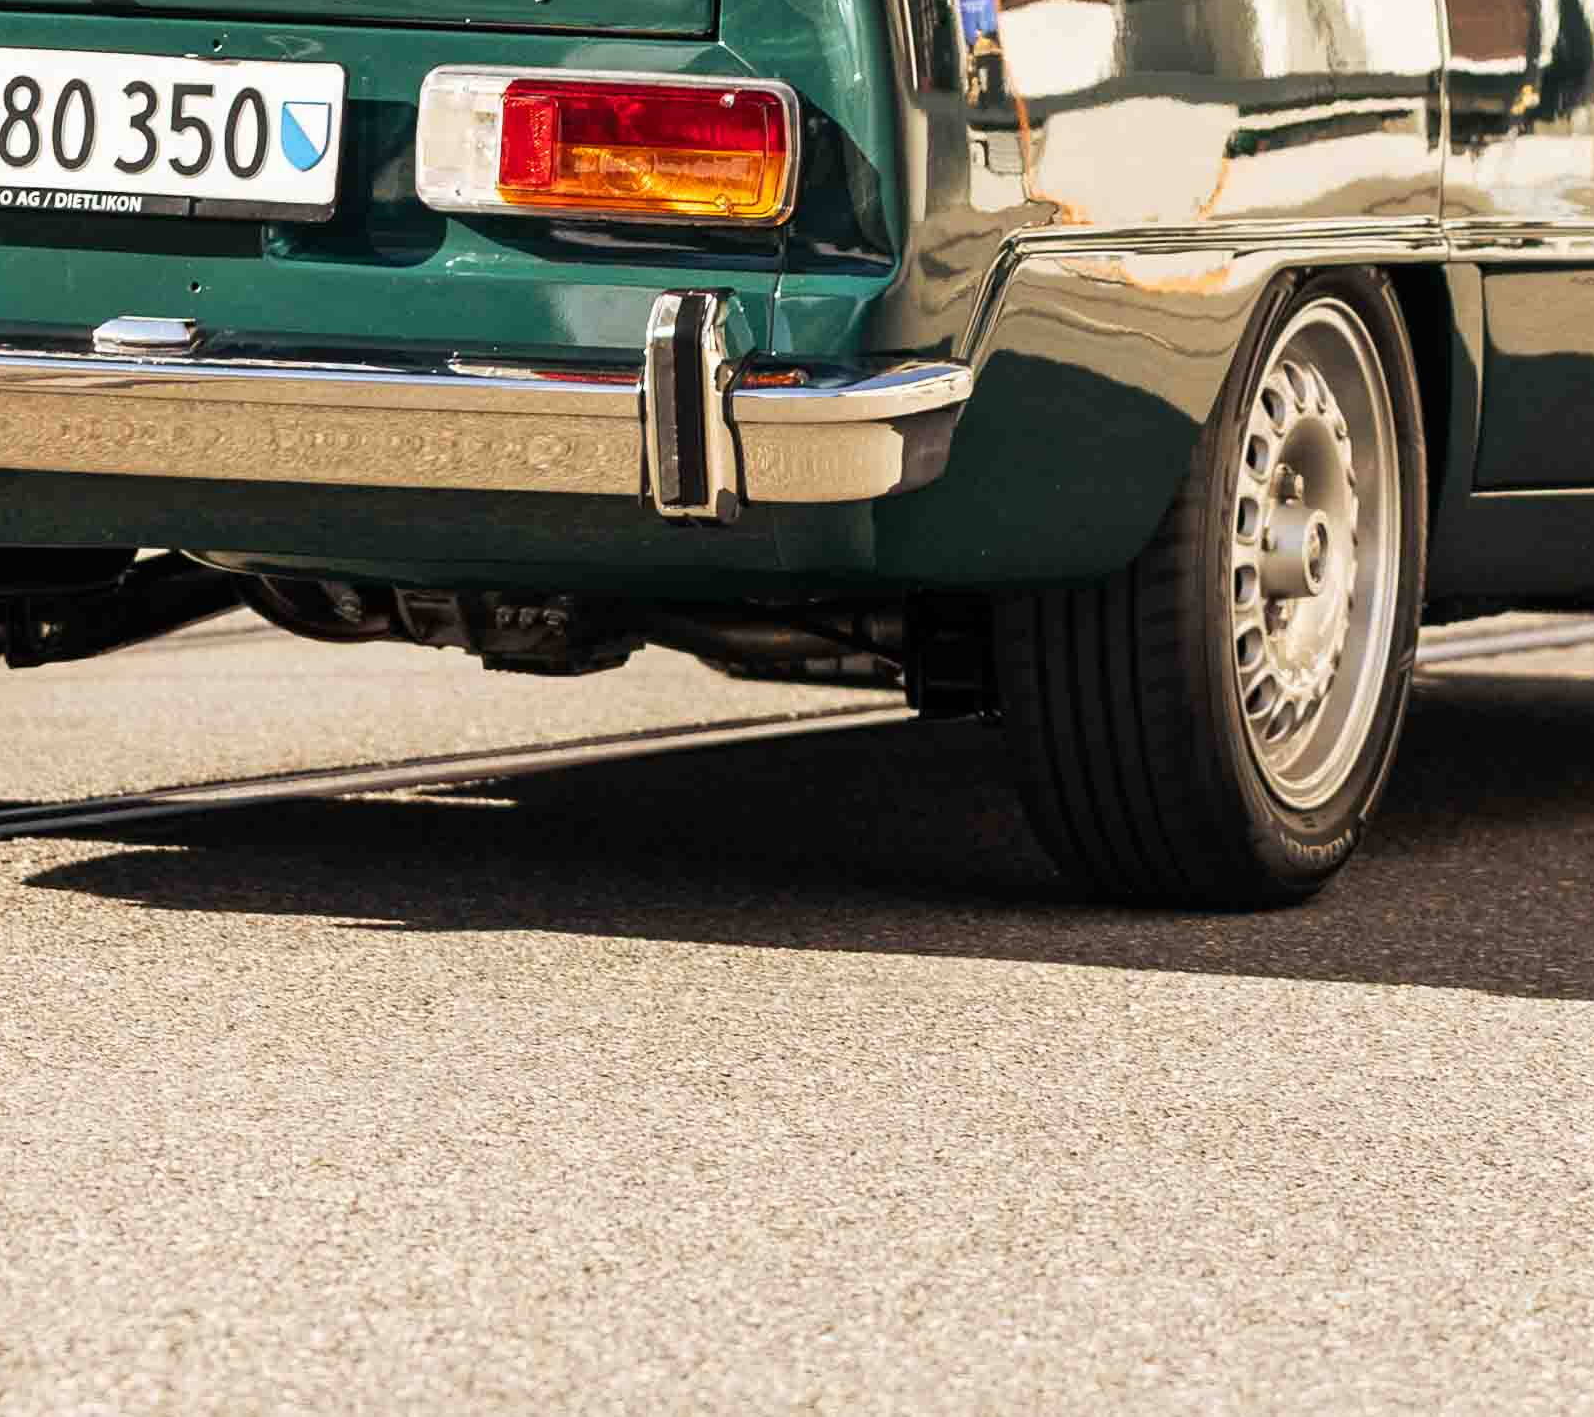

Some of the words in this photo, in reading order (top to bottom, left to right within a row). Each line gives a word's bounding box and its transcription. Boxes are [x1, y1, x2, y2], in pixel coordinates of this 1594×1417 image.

[114, 79, 269, 179] 350
[16, 191, 40, 207] AG
[42, 192, 51, 208] /
[54, 193, 143, 213] DIETLIKON
